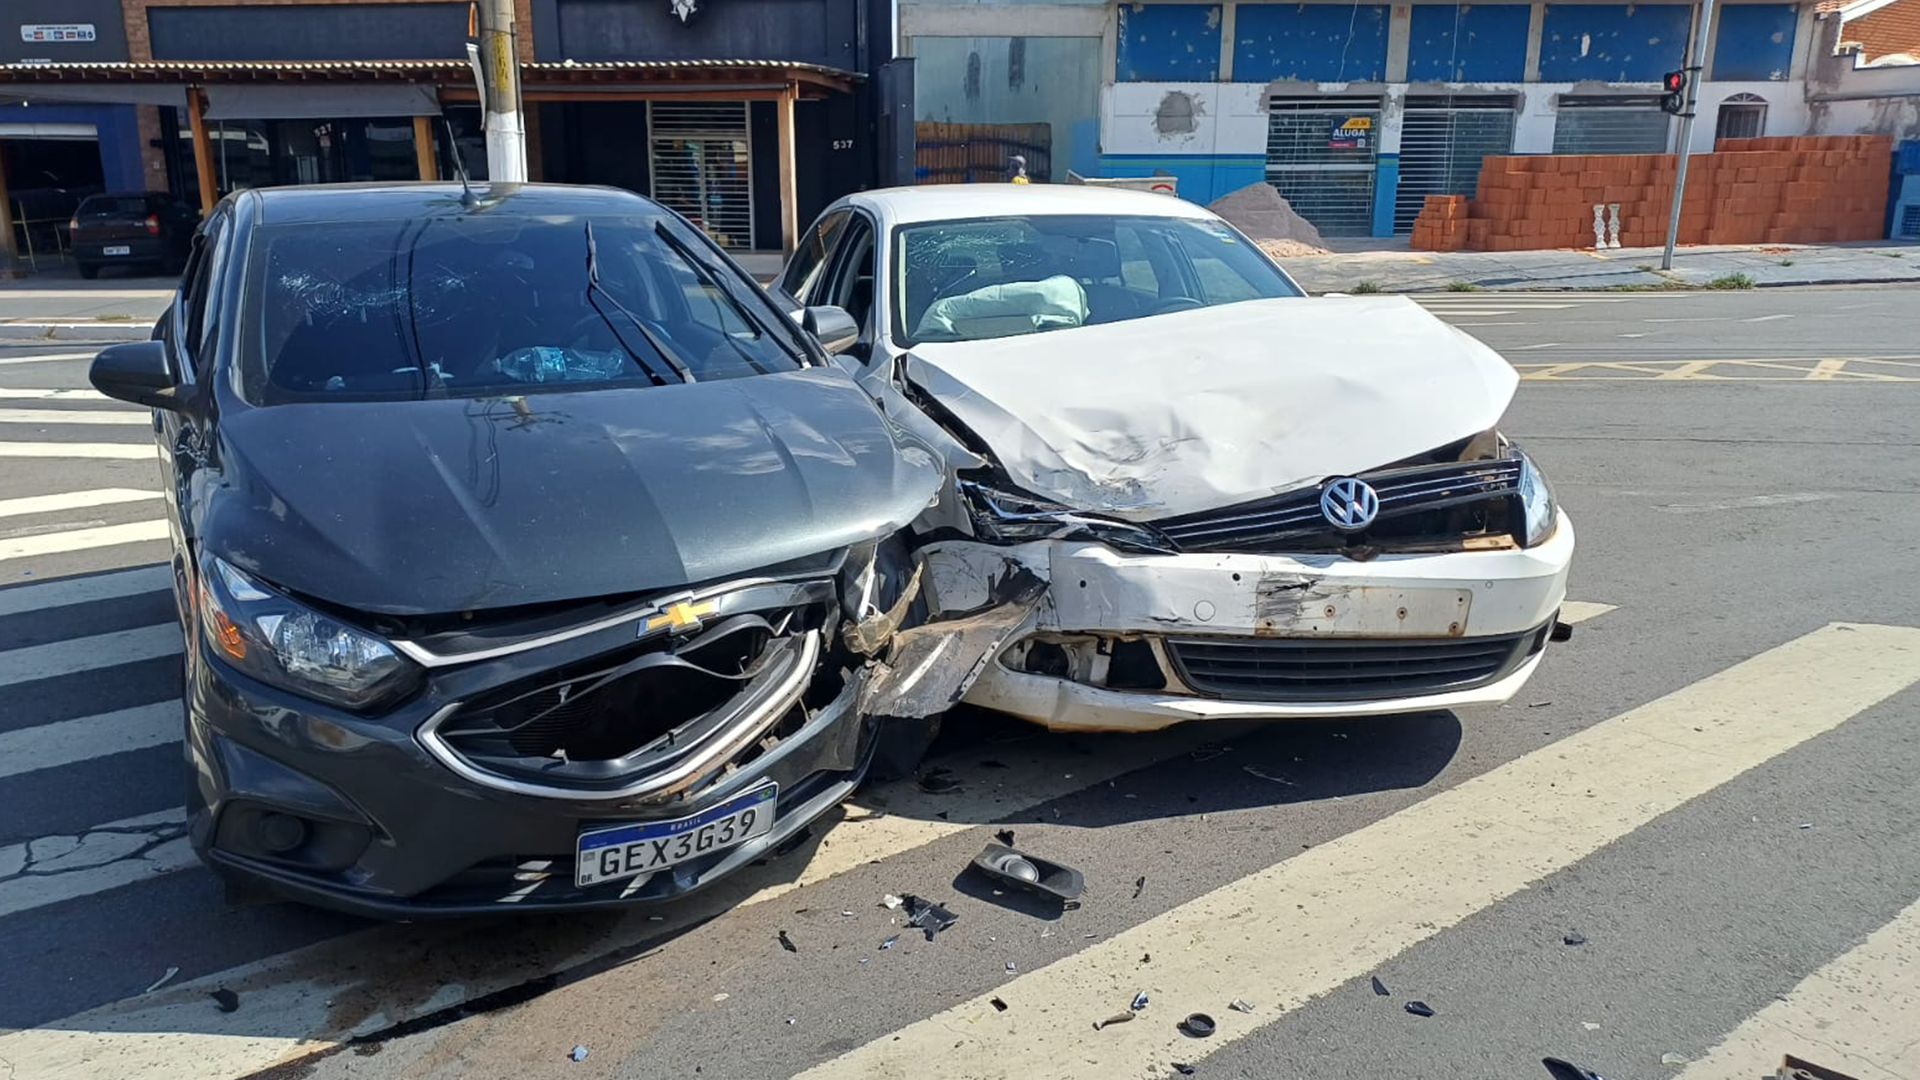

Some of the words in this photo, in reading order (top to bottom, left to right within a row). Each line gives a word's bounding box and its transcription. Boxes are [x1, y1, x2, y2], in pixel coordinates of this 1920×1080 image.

[1333, 128, 1366, 137] ALUGA
[833, 140, 853, 150] 537
[670, 817, 701, 831] BRASIL
[600, 809, 757, 876] GEX3G39
[580, 873, 593, 884] BR
